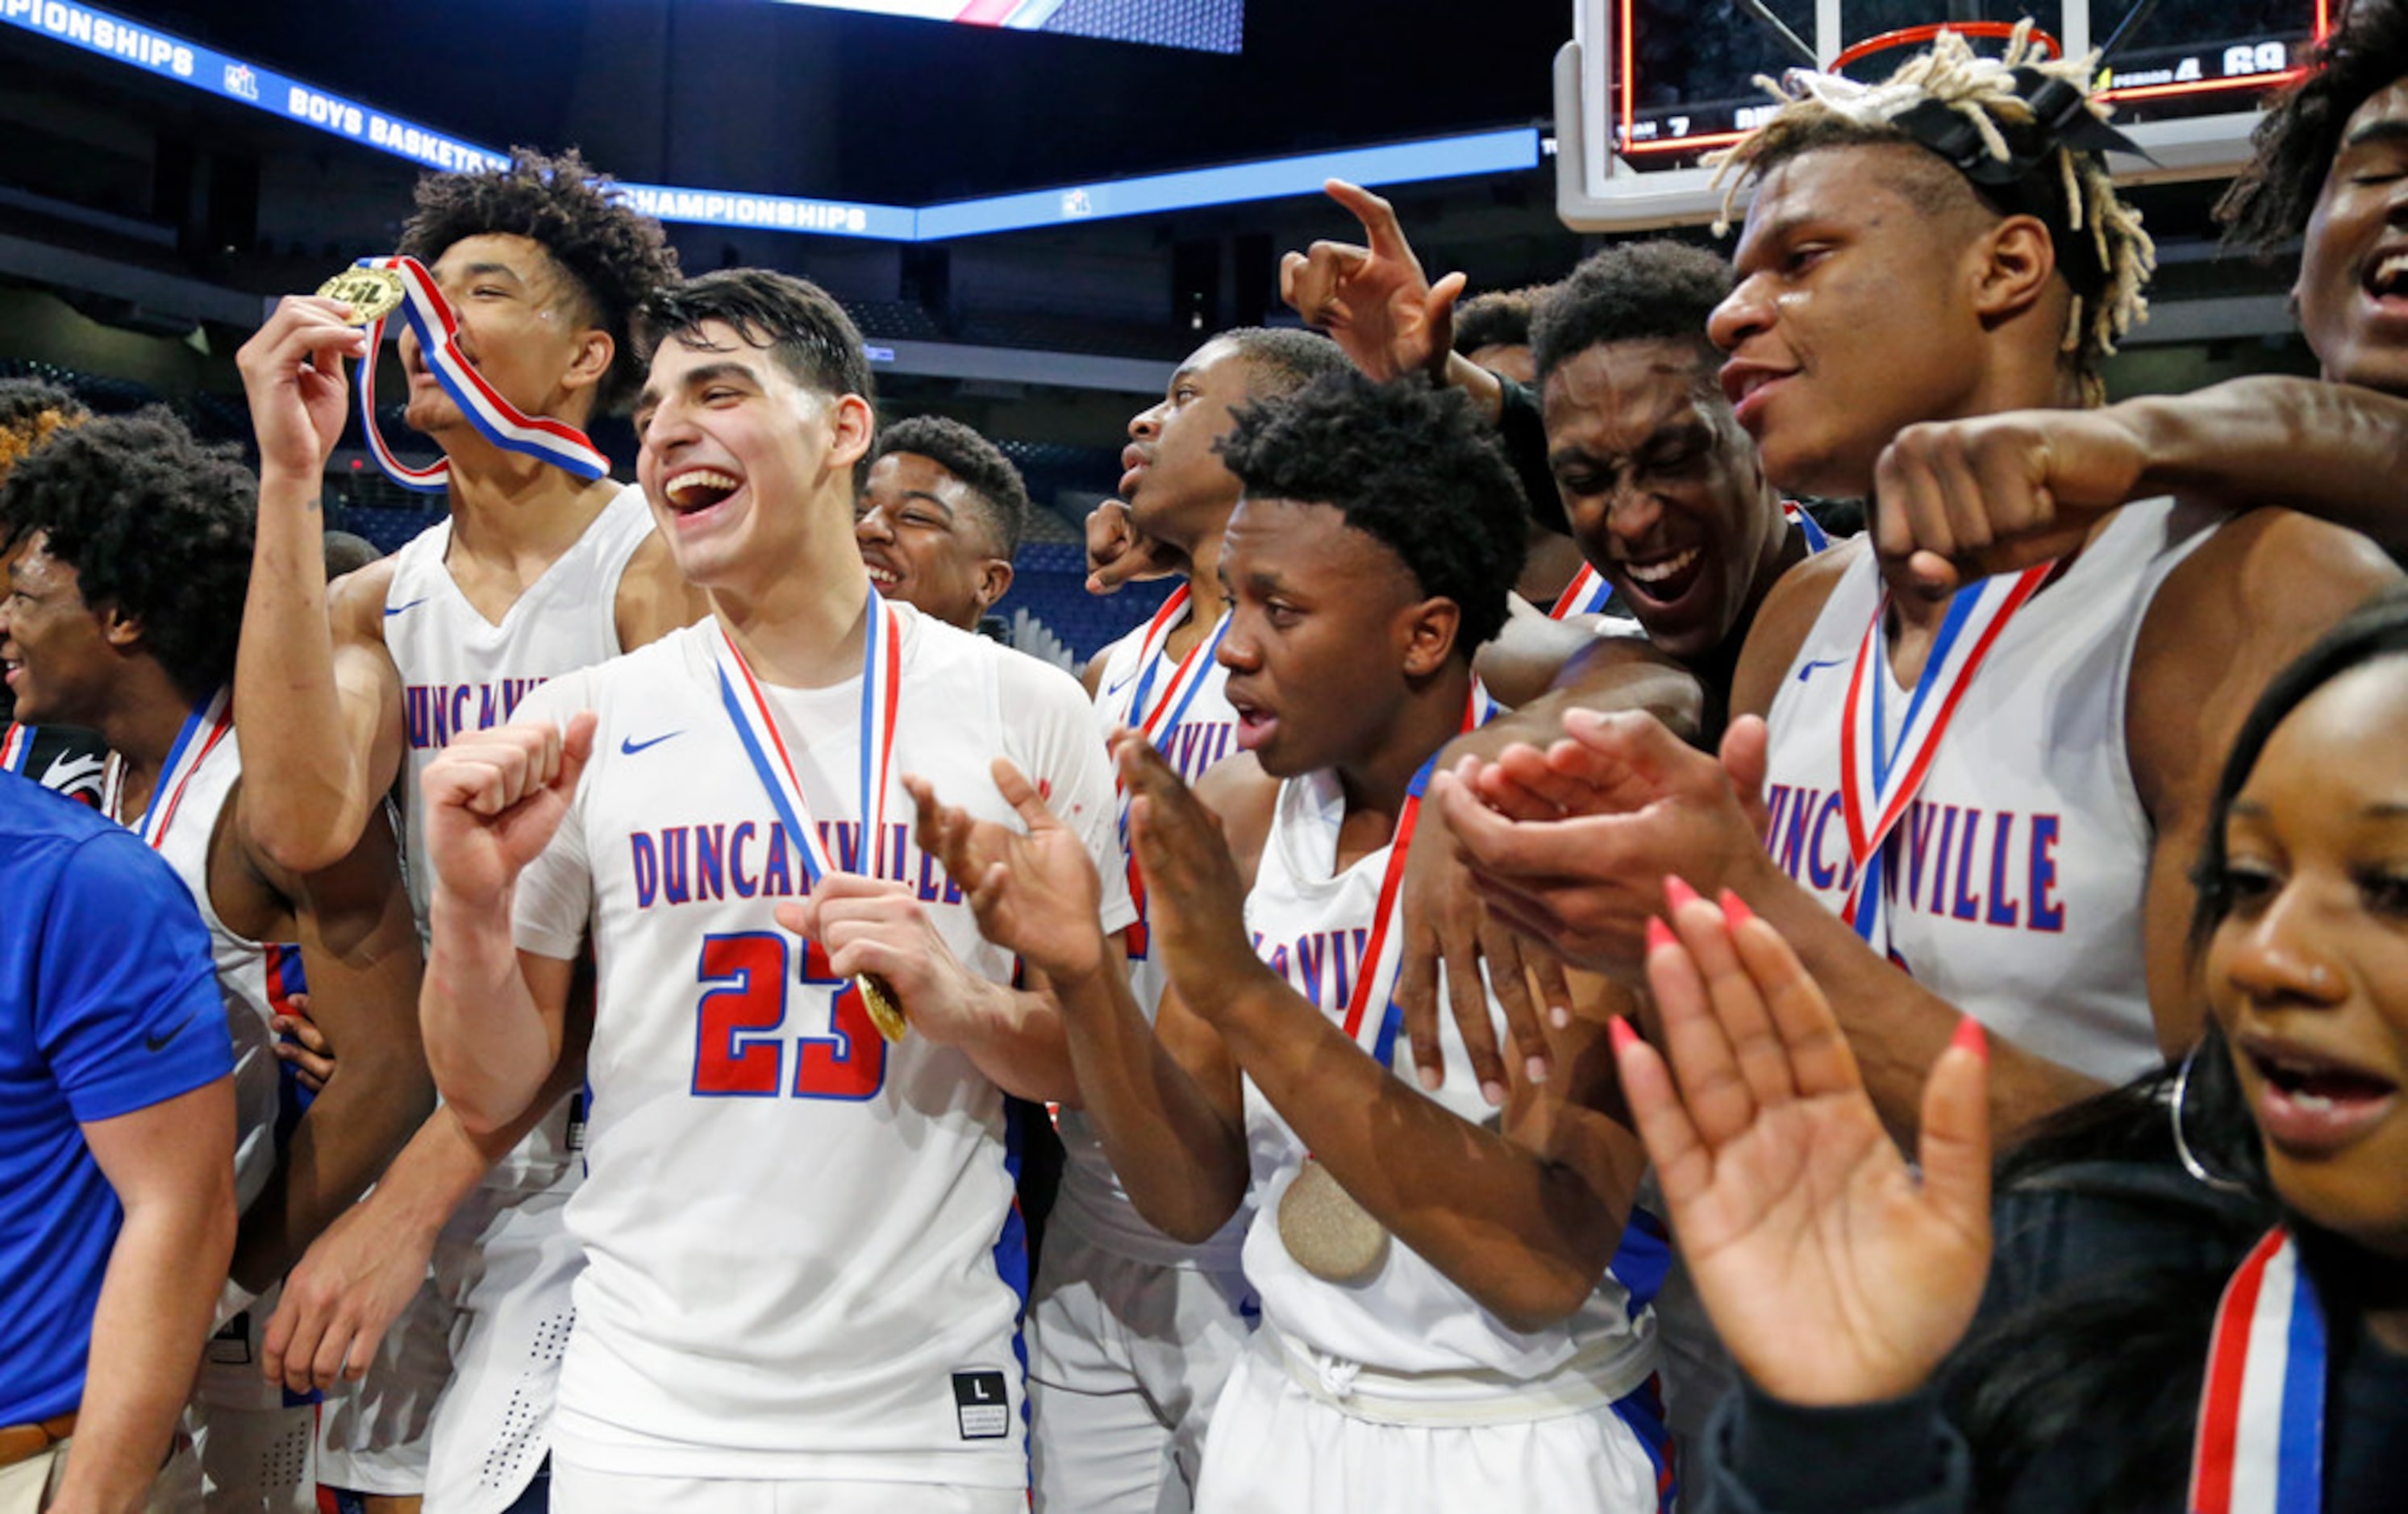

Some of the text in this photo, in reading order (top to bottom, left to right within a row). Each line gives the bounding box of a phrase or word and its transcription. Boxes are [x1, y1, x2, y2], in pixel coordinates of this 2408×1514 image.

[2174, 57, 2203, 81] 4
[2223, 42, 2286, 76] 69
[289, 85, 362, 135] BOYS
[1668, 115, 1690, 137] 7
[690, 930, 888, 1101] 23
[973, 1378, 989, 1400] L
